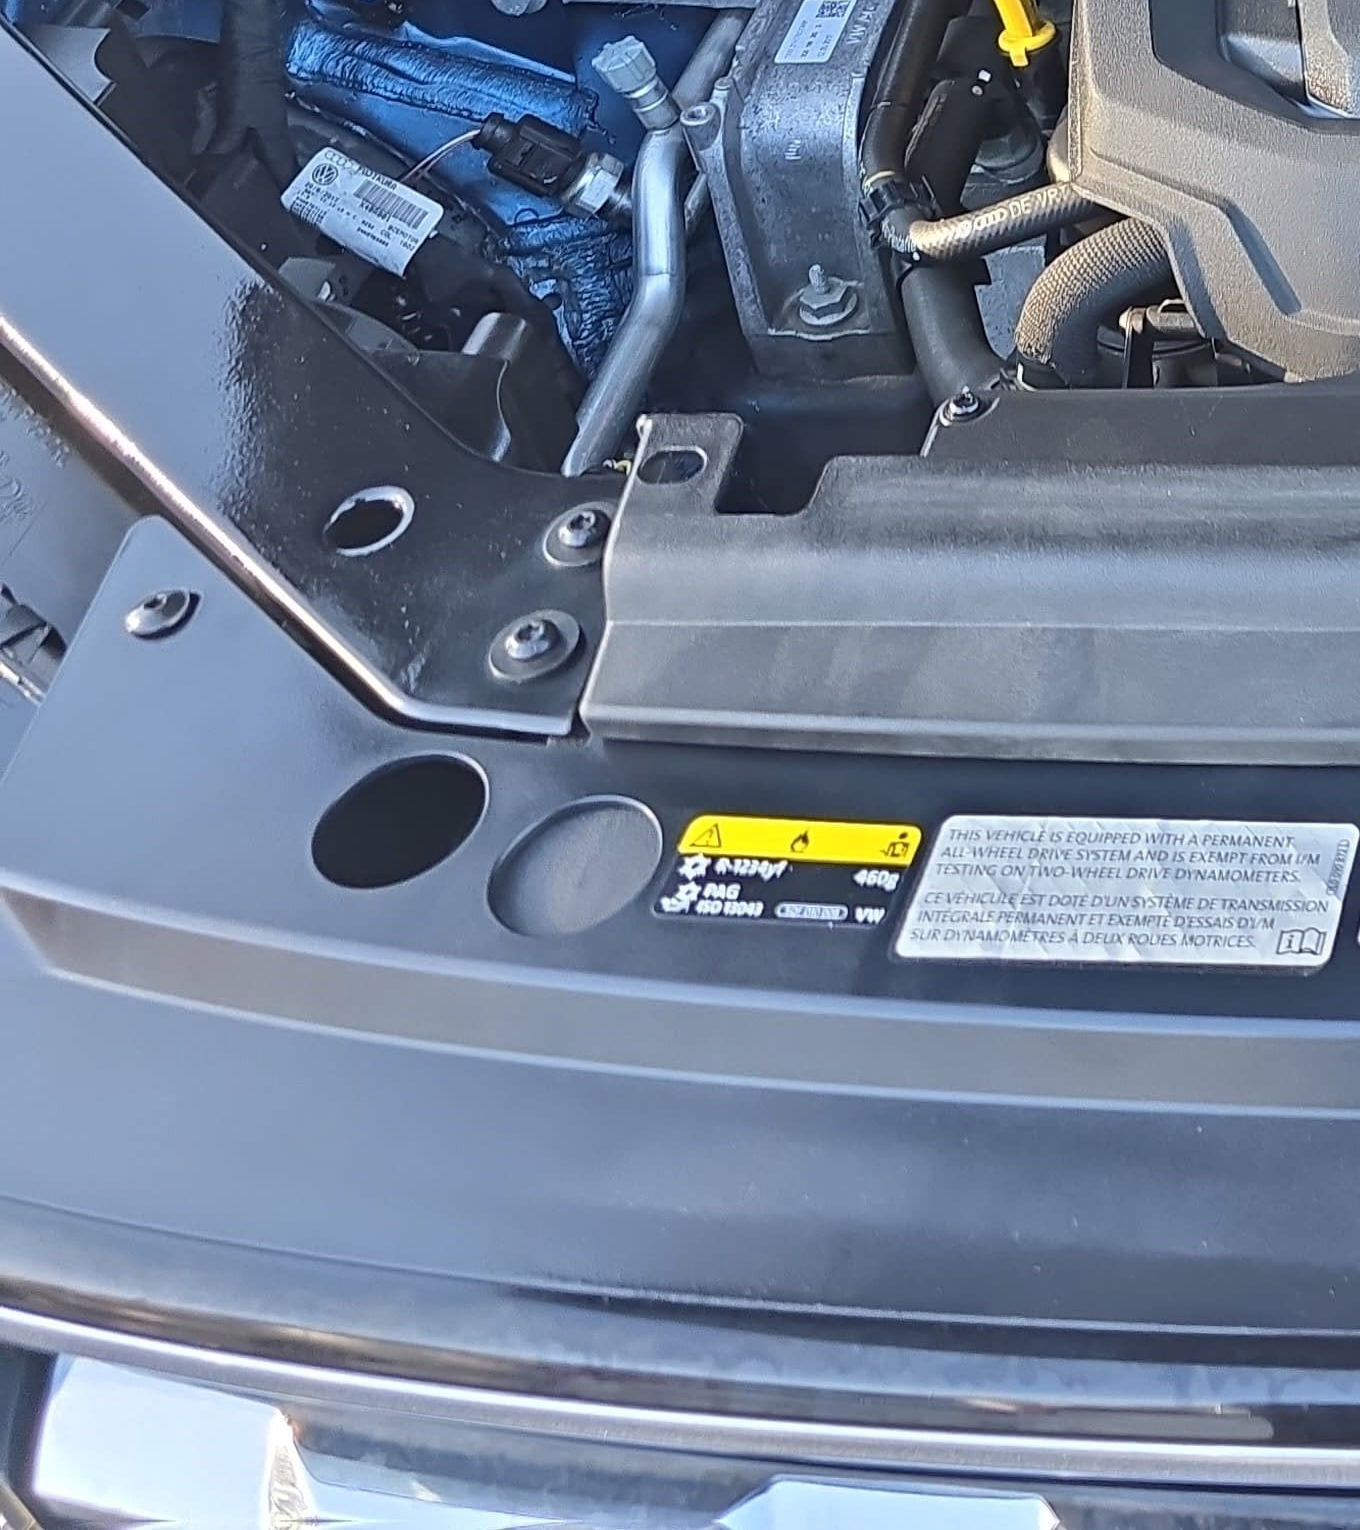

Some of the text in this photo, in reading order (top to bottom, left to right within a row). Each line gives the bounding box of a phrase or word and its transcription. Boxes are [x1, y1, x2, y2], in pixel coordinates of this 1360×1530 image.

[1010, 198, 1032, 219] DE
[949, 828, 1295, 848] THIS VEHICLE IS EQUIPPED WITH A PERMANENT
[940, 846, 1024, 860] ALL-WHEEL
[1027, 848, 1074, 861] DRIVE
[1076, 849, 1132, 862] SYSTEM
[1134, 849, 1169, 863] AND
[1172, 850, 1185, 864] IS
[1188, 851, 1249, 865] EXEMPT
[1249, 853, 1291, 866] FROM
[853, 868, 901, 892] 460g
[936, 863, 999, 877] TESTING
[1000, 864, 1026, 878] ON
[1028, 865, 1123, 880] TWO-WHEEL
[1126, 867, 1171, 881] DRIVE
[702, 882, 742, 901] PAG
[695, 899, 723, 916] ISO
[854, 907, 886, 925] VW
[924, 893, 944, 905] CE
[1020, 894, 1045, 907] EST
[1197, 898, 1218, 911] DE
[1219, 898, 1330, 913] TRANSMISSION
